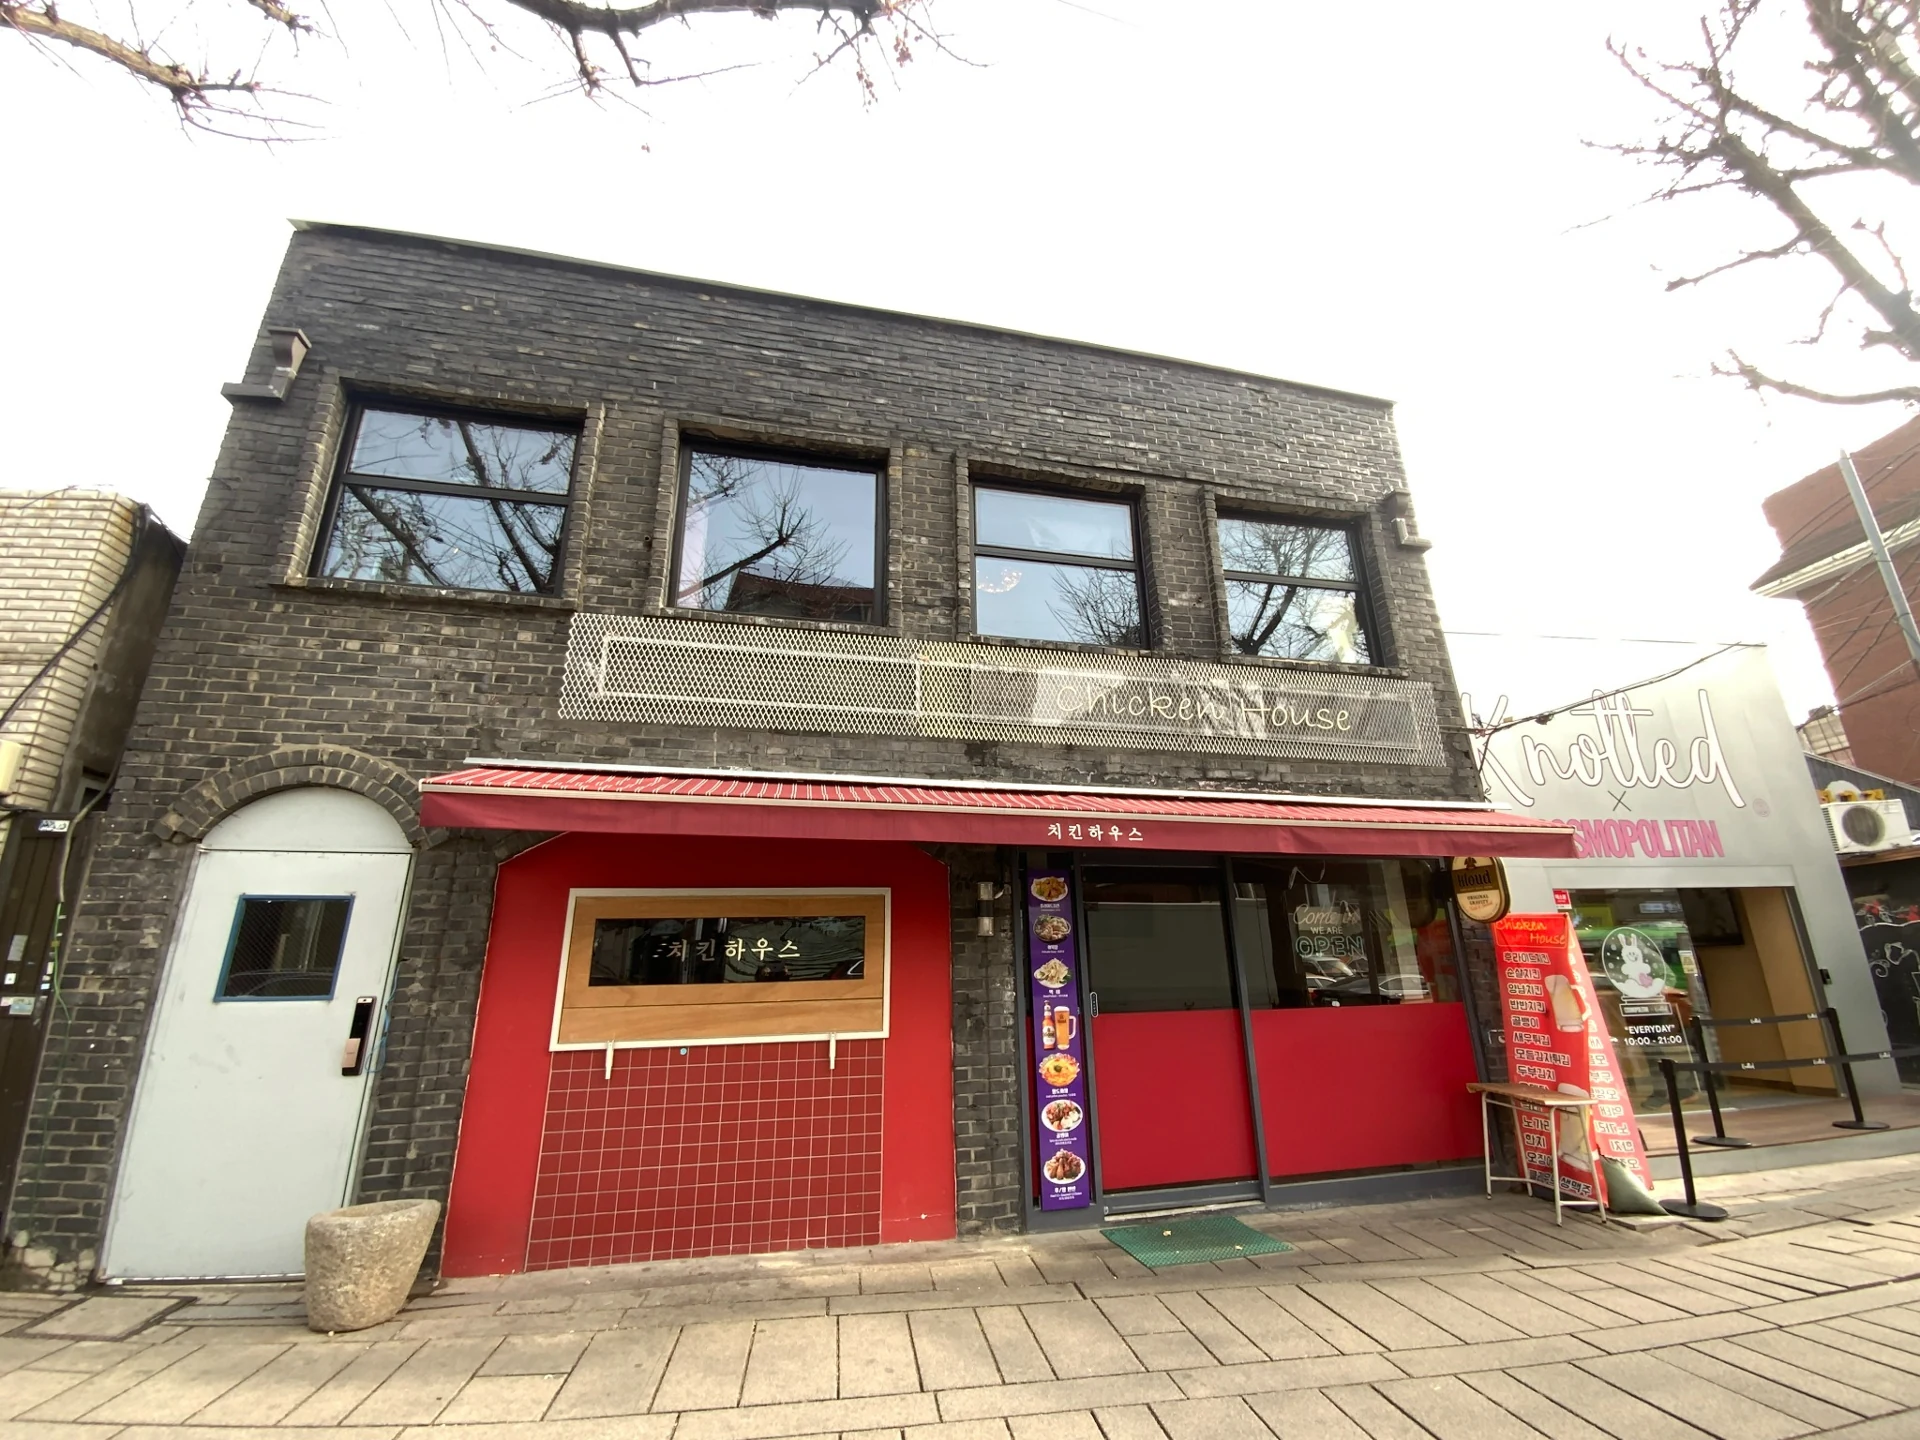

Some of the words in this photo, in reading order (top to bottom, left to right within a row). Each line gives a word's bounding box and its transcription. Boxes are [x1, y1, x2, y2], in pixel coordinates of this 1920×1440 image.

[1057, 683, 1224, 721] Chicken
[1241, 687, 1352, 731] House
[1461, 688, 1747, 808] Knotted
[1047, 822, 1144, 842] 치킨하우스
[1547, 819, 1725, 858] SMOPOLITAN
[1310, 926, 1326, 935] WE
[1326, 926, 1344, 935] ARE
[1496, 918, 1547, 931] Chicken
[1295, 935, 1365, 958] OPEN
[1529, 932, 1566, 945] House
[667, 937, 801, 962] 치킨하우스
[1504, 951, 1551, 965] 후라이드치킨
[1506, 967, 1541, 980] 순살치킨
[1508, 983, 1543, 996] 양념치킨
[1509, 998, 1546, 1013] 반반치킨
[1513, 1031, 1551, 1047] 새우튀김
[1624, 1037, 1650, 1046] 10:00
[1657, 1035, 1682, 1045] 21:00
[1517, 1064, 1556, 1081] 두부김치
[1560, 1176, 1592, 1197] 생맥주
